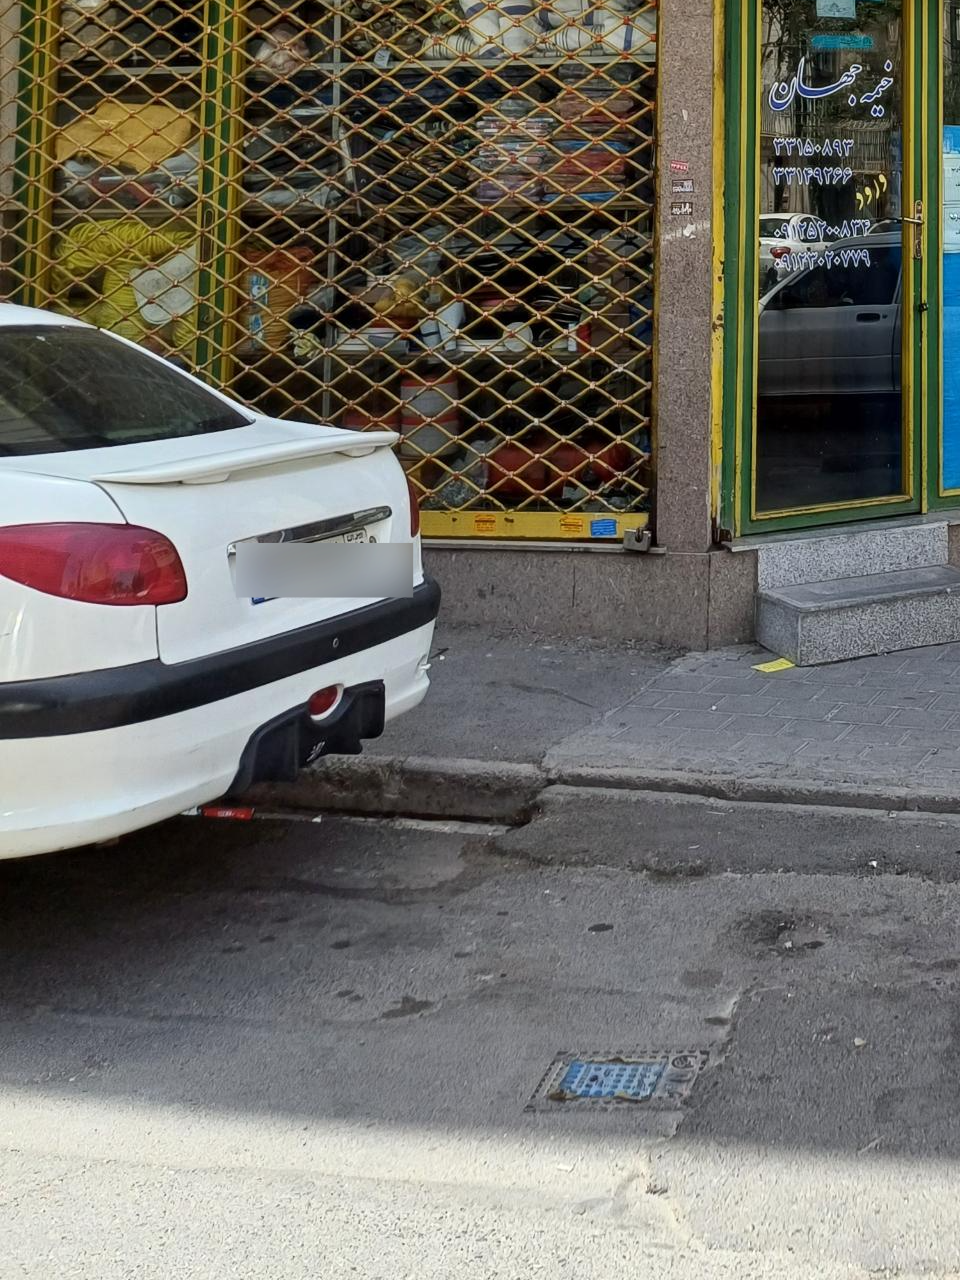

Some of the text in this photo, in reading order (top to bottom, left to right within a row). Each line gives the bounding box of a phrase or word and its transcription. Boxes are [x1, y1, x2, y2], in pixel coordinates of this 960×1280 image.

[769, 56, 894, 117] خیمه جهان
[773, 138, 854, 157] ۳۳۱۵۰۸۹۳
[773, 166, 853, 186] ۳۳۱۴۹۲۶۶
[855, 173, 888, 211] ورود
[774, 219, 871, 241] ۰۹۱۲۵۲۰۰۸۳۴
[774, 249, 871, 271] ۰۹۱۲۳۰۲۰۷۷۹
